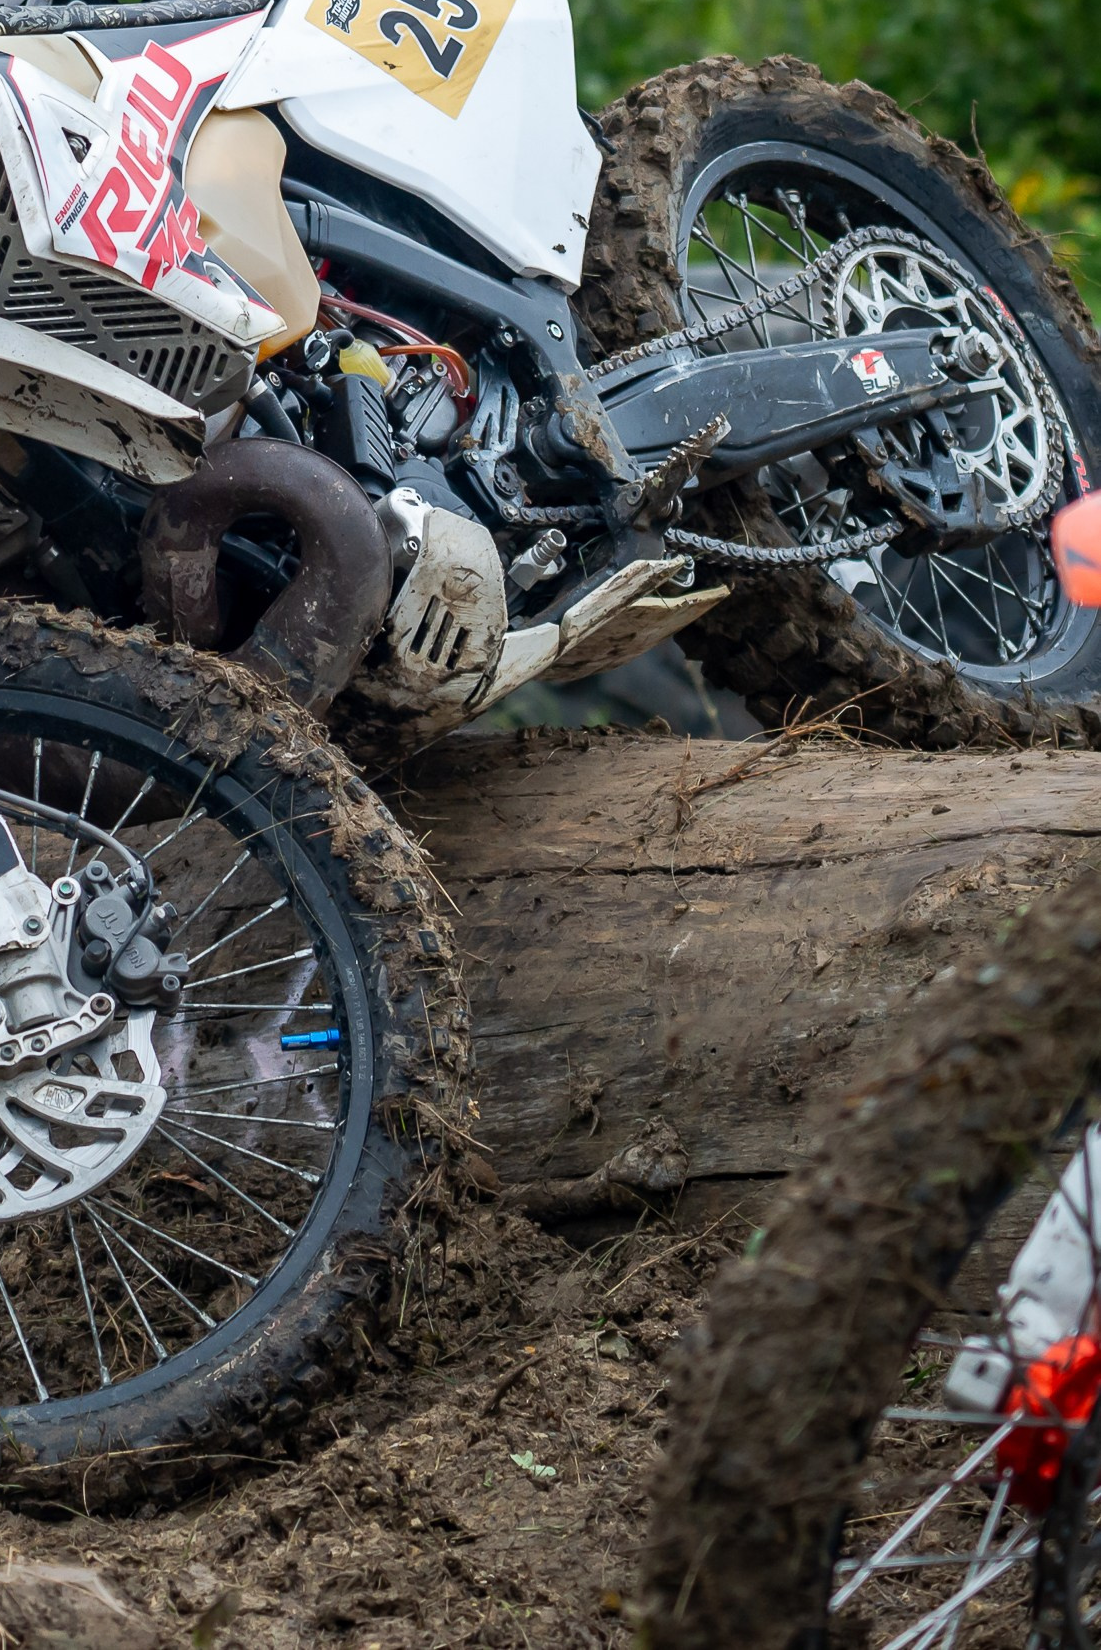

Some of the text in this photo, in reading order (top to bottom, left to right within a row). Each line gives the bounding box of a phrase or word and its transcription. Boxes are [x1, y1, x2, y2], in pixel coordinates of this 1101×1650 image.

[79, 42, 191, 268] RIEJU
[55, 184, 81, 225] ENDURO
[61, 191, 89, 235] RANGER
